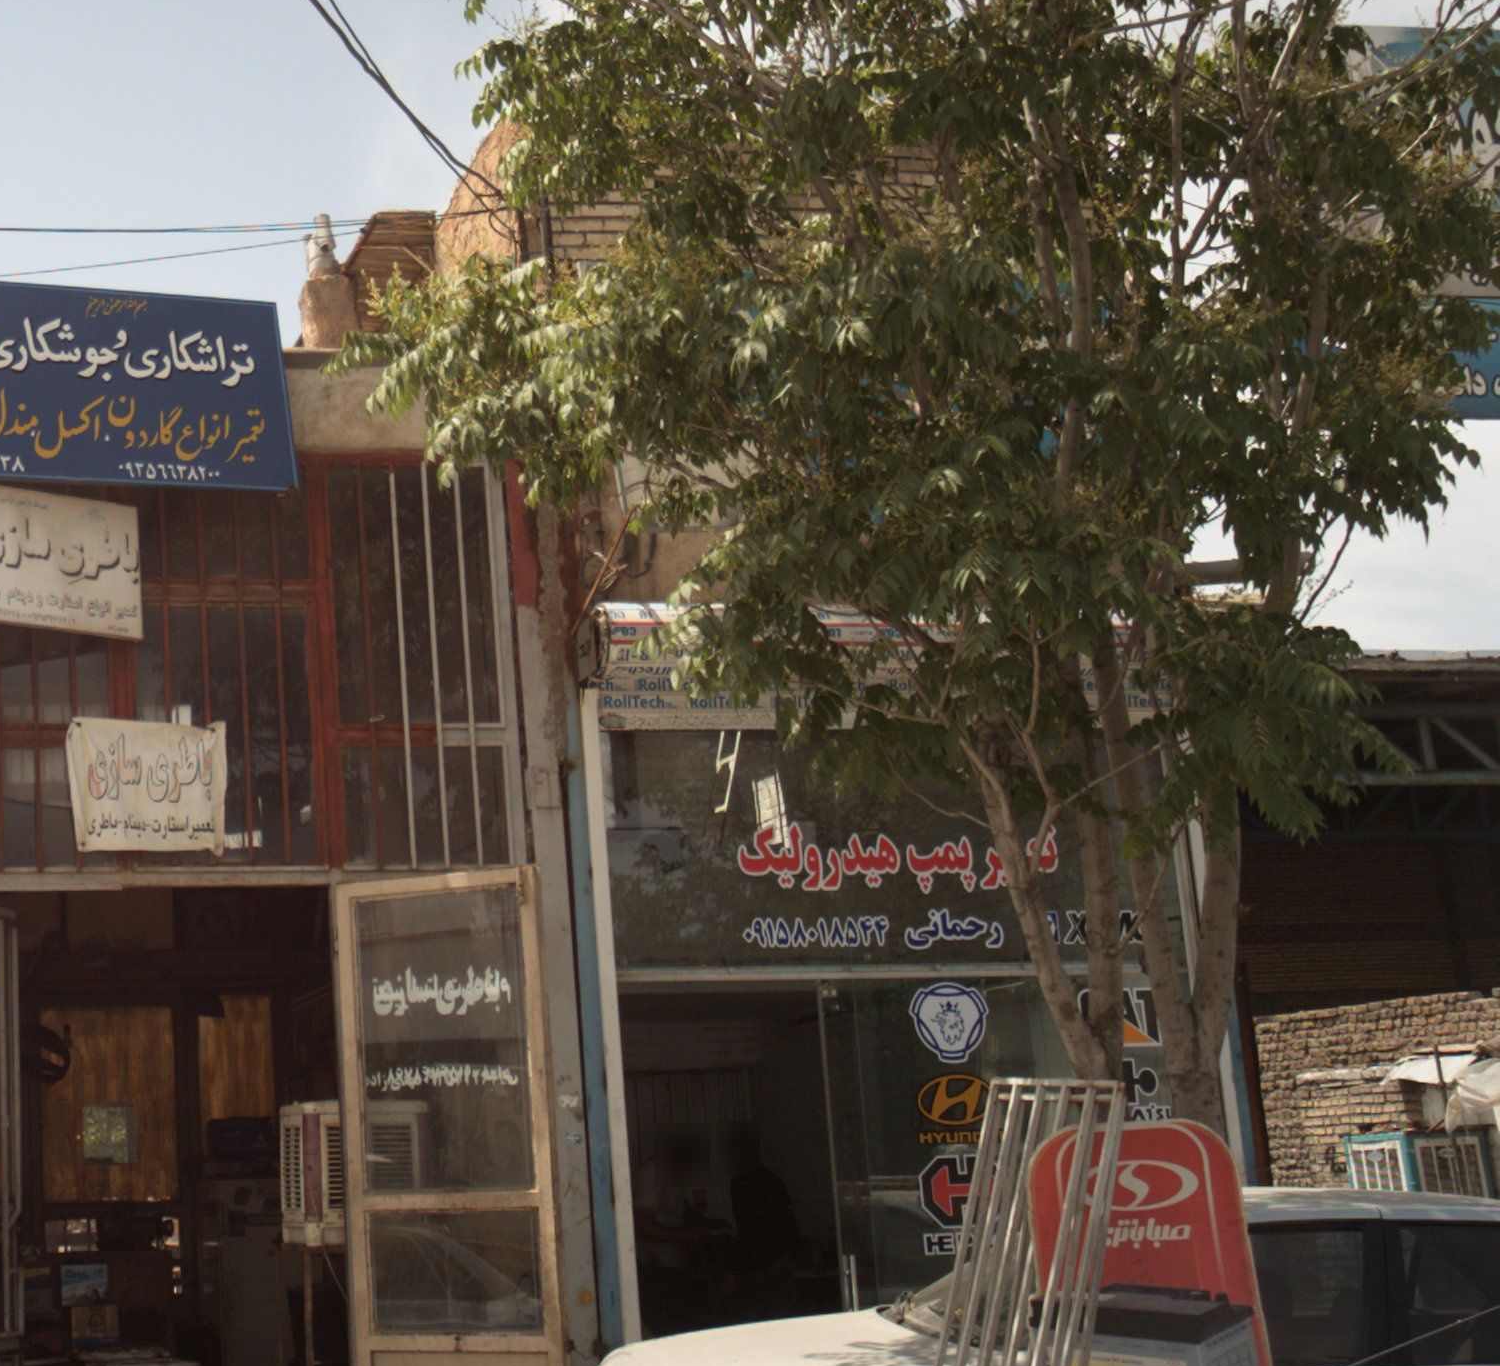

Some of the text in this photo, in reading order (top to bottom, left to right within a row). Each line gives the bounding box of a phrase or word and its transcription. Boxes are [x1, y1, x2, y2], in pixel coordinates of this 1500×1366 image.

[124, 330, 256, 387] تراشکاری
[174, 413, 230, 462] انواع
[225, 408, 266, 463] تعمیر
[603, 695, 665, 709] RollTech
[87, 733, 213, 803] باطری سازی
[87, 811, 117, 837] باطری
[152, 815, 188, 839] استارت
[188, 817, 215, 840] تعمیر
[737, 821, 900, 891] هیدرولیک
[906, 835, 974, 894] پمپ
[742, 916, 890, 948] ۰۹۱۵۸۰۱۸۵۴۴
[905, 907, 1004, 949] رحمانی
